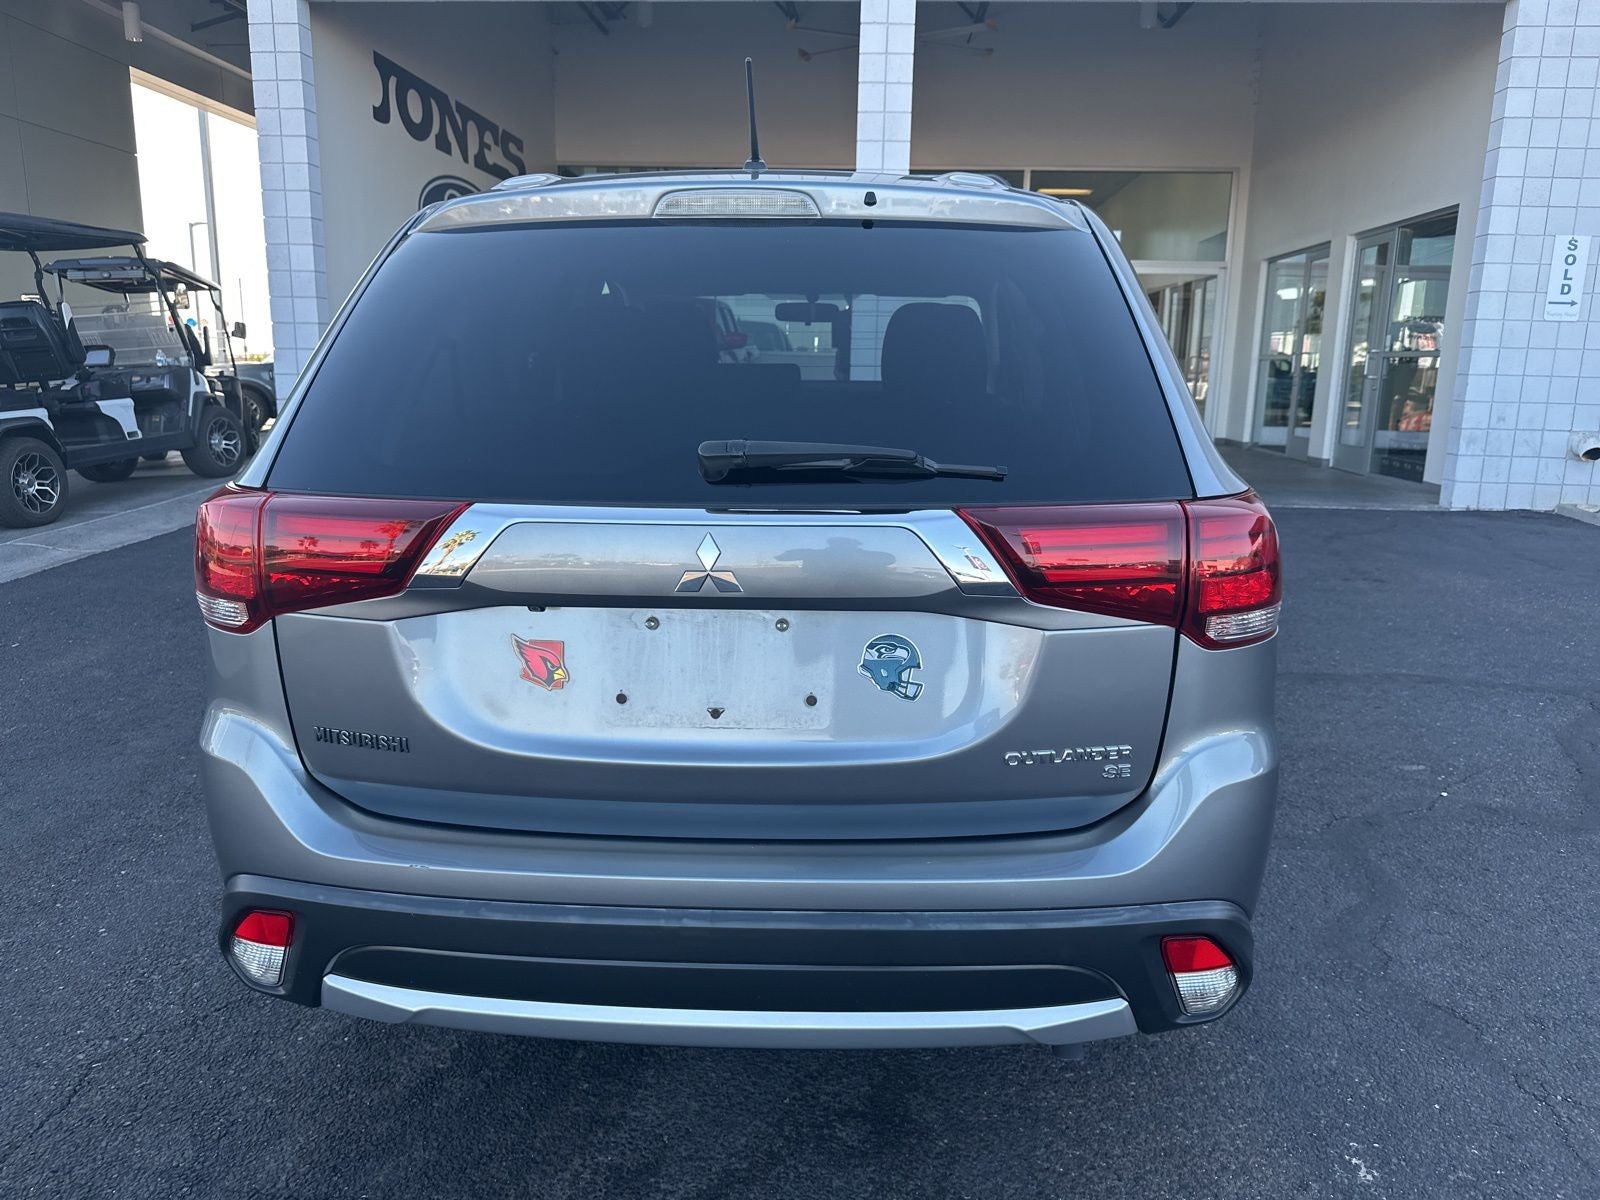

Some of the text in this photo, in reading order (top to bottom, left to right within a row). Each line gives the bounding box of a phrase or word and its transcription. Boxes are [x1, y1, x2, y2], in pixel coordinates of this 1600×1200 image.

[372, 49, 527, 180] JONES
[1559, 238, 1579, 296] SOLD
[313, 726, 411, 753] MITSUBISHI
[1004, 745, 1133, 766] OUTLANDER
[1102, 764, 1132, 779] SE
